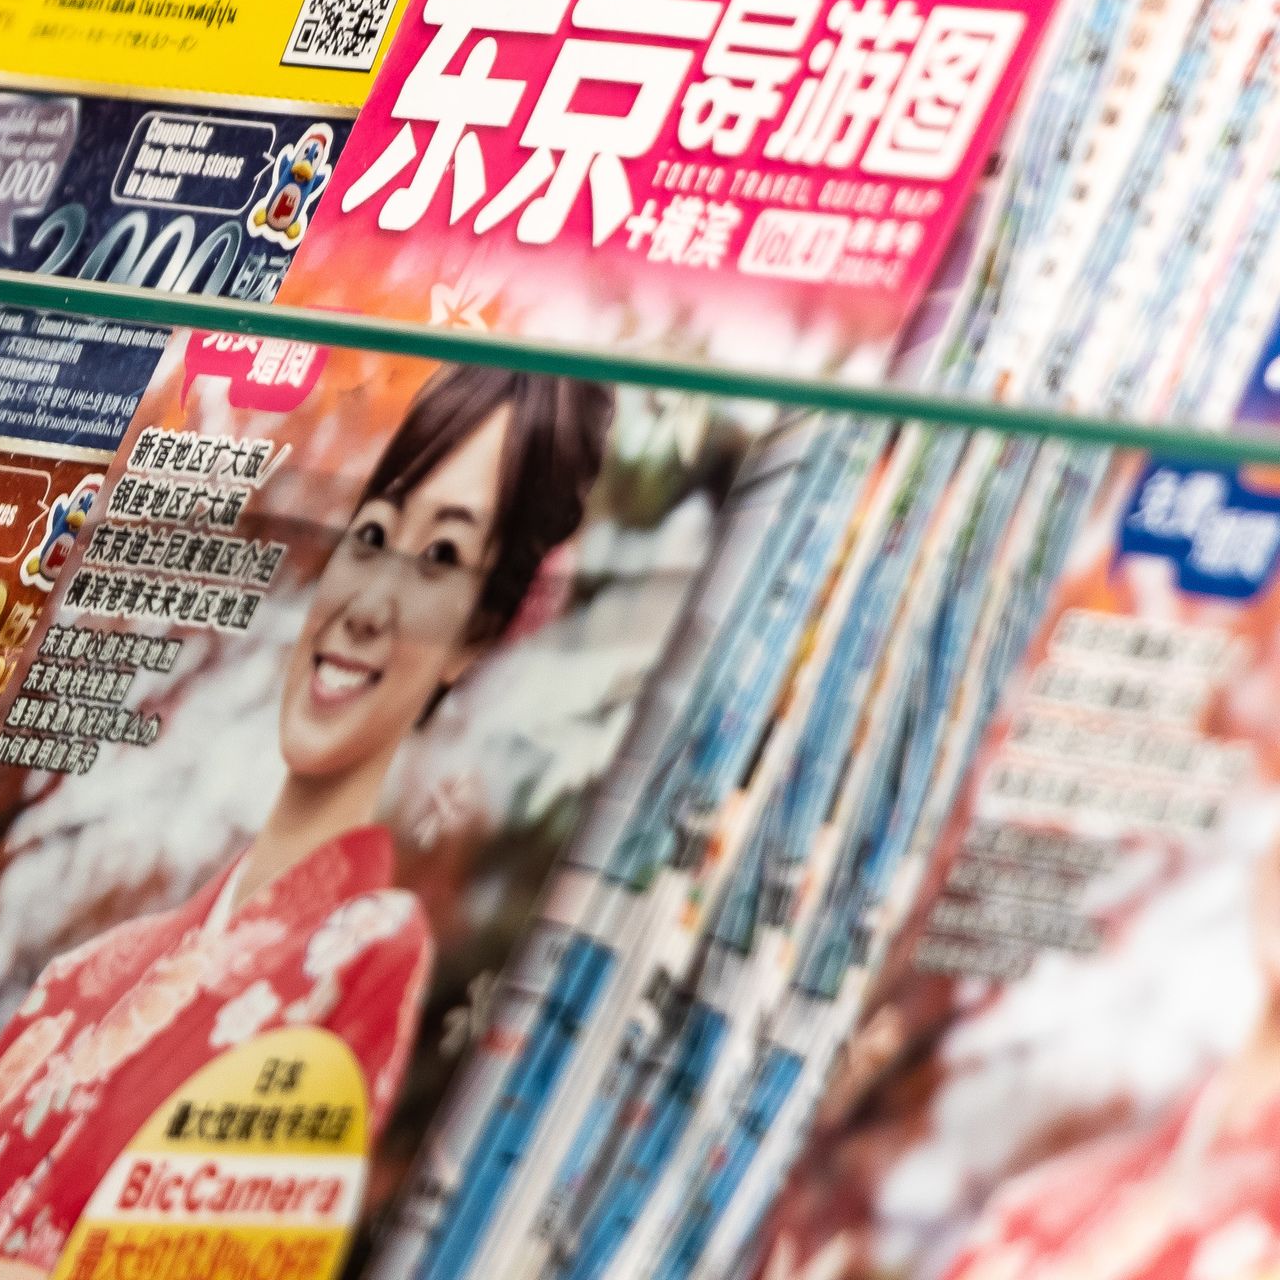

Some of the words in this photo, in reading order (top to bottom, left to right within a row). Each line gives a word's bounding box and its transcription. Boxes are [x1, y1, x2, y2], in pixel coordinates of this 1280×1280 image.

[144, 116, 194, 146] Coupon
[192, 121, 214, 148] for
[122, 170, 142, 196] in
[134, 143, 162, 170] Don
[160, 144, 206, 176] Quijote
[203, 152, 245, 180] stores
[652, 160, 725, 195] TOKYO
[729, 168, 812, 207] TRAVEL
[131, 431, 270, 480] 新宿地区扩大版
[108, 478, 247, 529] 银座地区扩大版
[86, 524, 284, 584] 东京迪士尼度假区介绍
[64, 570, 262, 631] 横滨港湾未来地区地图
[116, 1159, 345, 1214] BicCamera
